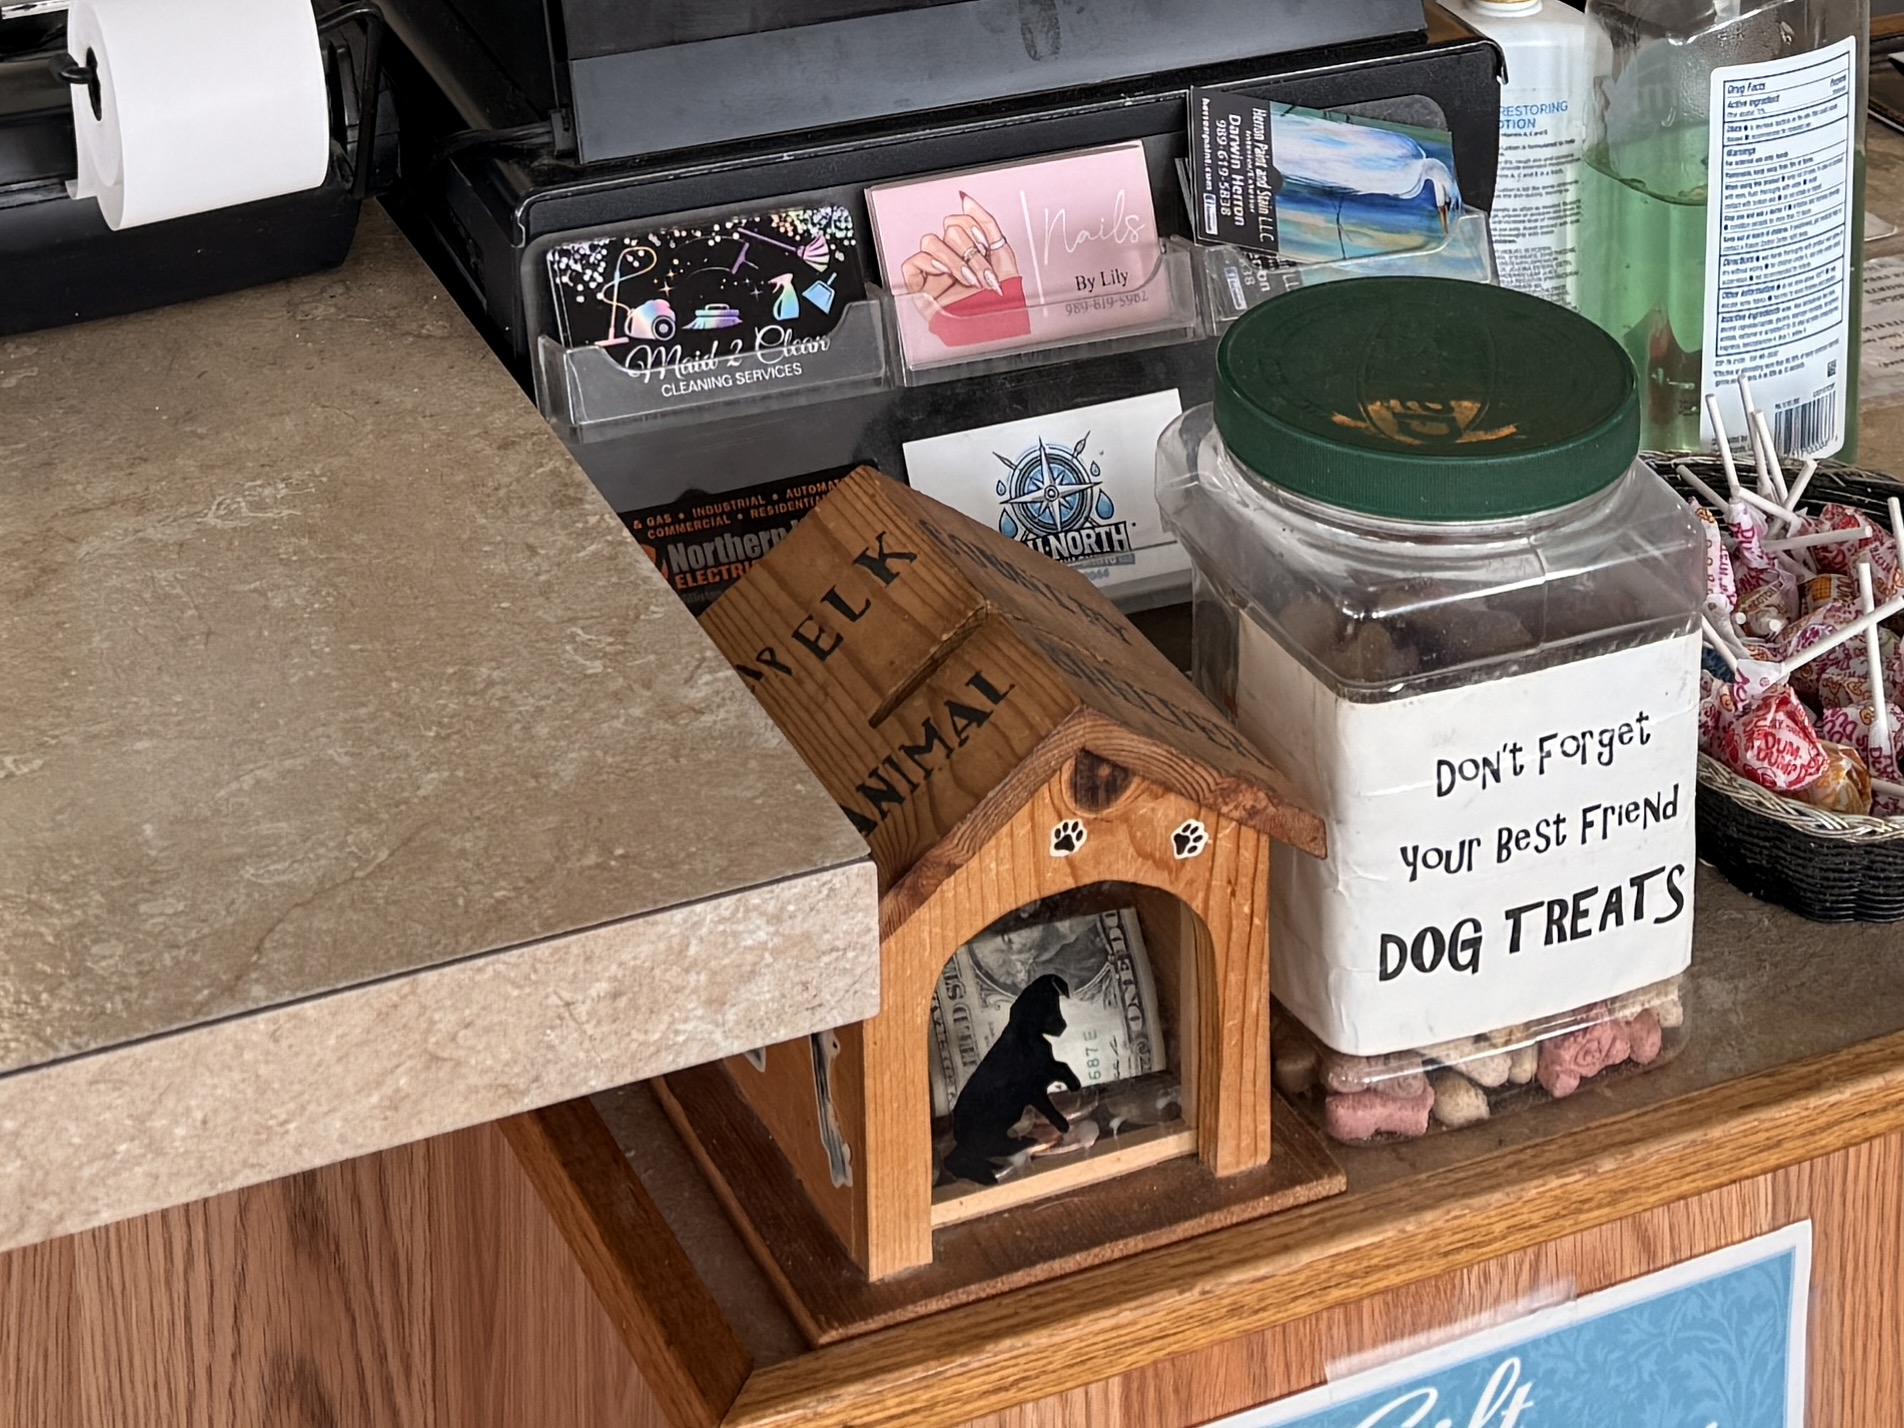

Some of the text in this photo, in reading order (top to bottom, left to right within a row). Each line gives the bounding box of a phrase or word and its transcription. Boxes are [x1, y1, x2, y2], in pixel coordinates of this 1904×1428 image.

[1228, 114, 1245, 227] Darwin Herron
[1251, 107, 1275, 243] Herron Paint and Stain LLC
[1044, 188, 1145, 266] Nails
[1075, 268, 1129, 293] By Lily
[625, 324, 832, 383] Maid 2 Clean
[660, 362, 803, 398] CLEANING SERVICES
[646, 513, 672, 528] GAS
[692, 494, 766, 518] INDUSTRIAL
[786, 479, 841, 499] AUTOMAT
[647, 516, 732, 539] COMMERCIAL
[674, 560, 756, 590] ELECTRI
[791, 530, 918, 663] ELK
[1537, 710, 1653, 776] Forget
[1495, 811, 1568, 865] Best
[1378, 862, 1686, 983] DOG TREATS
